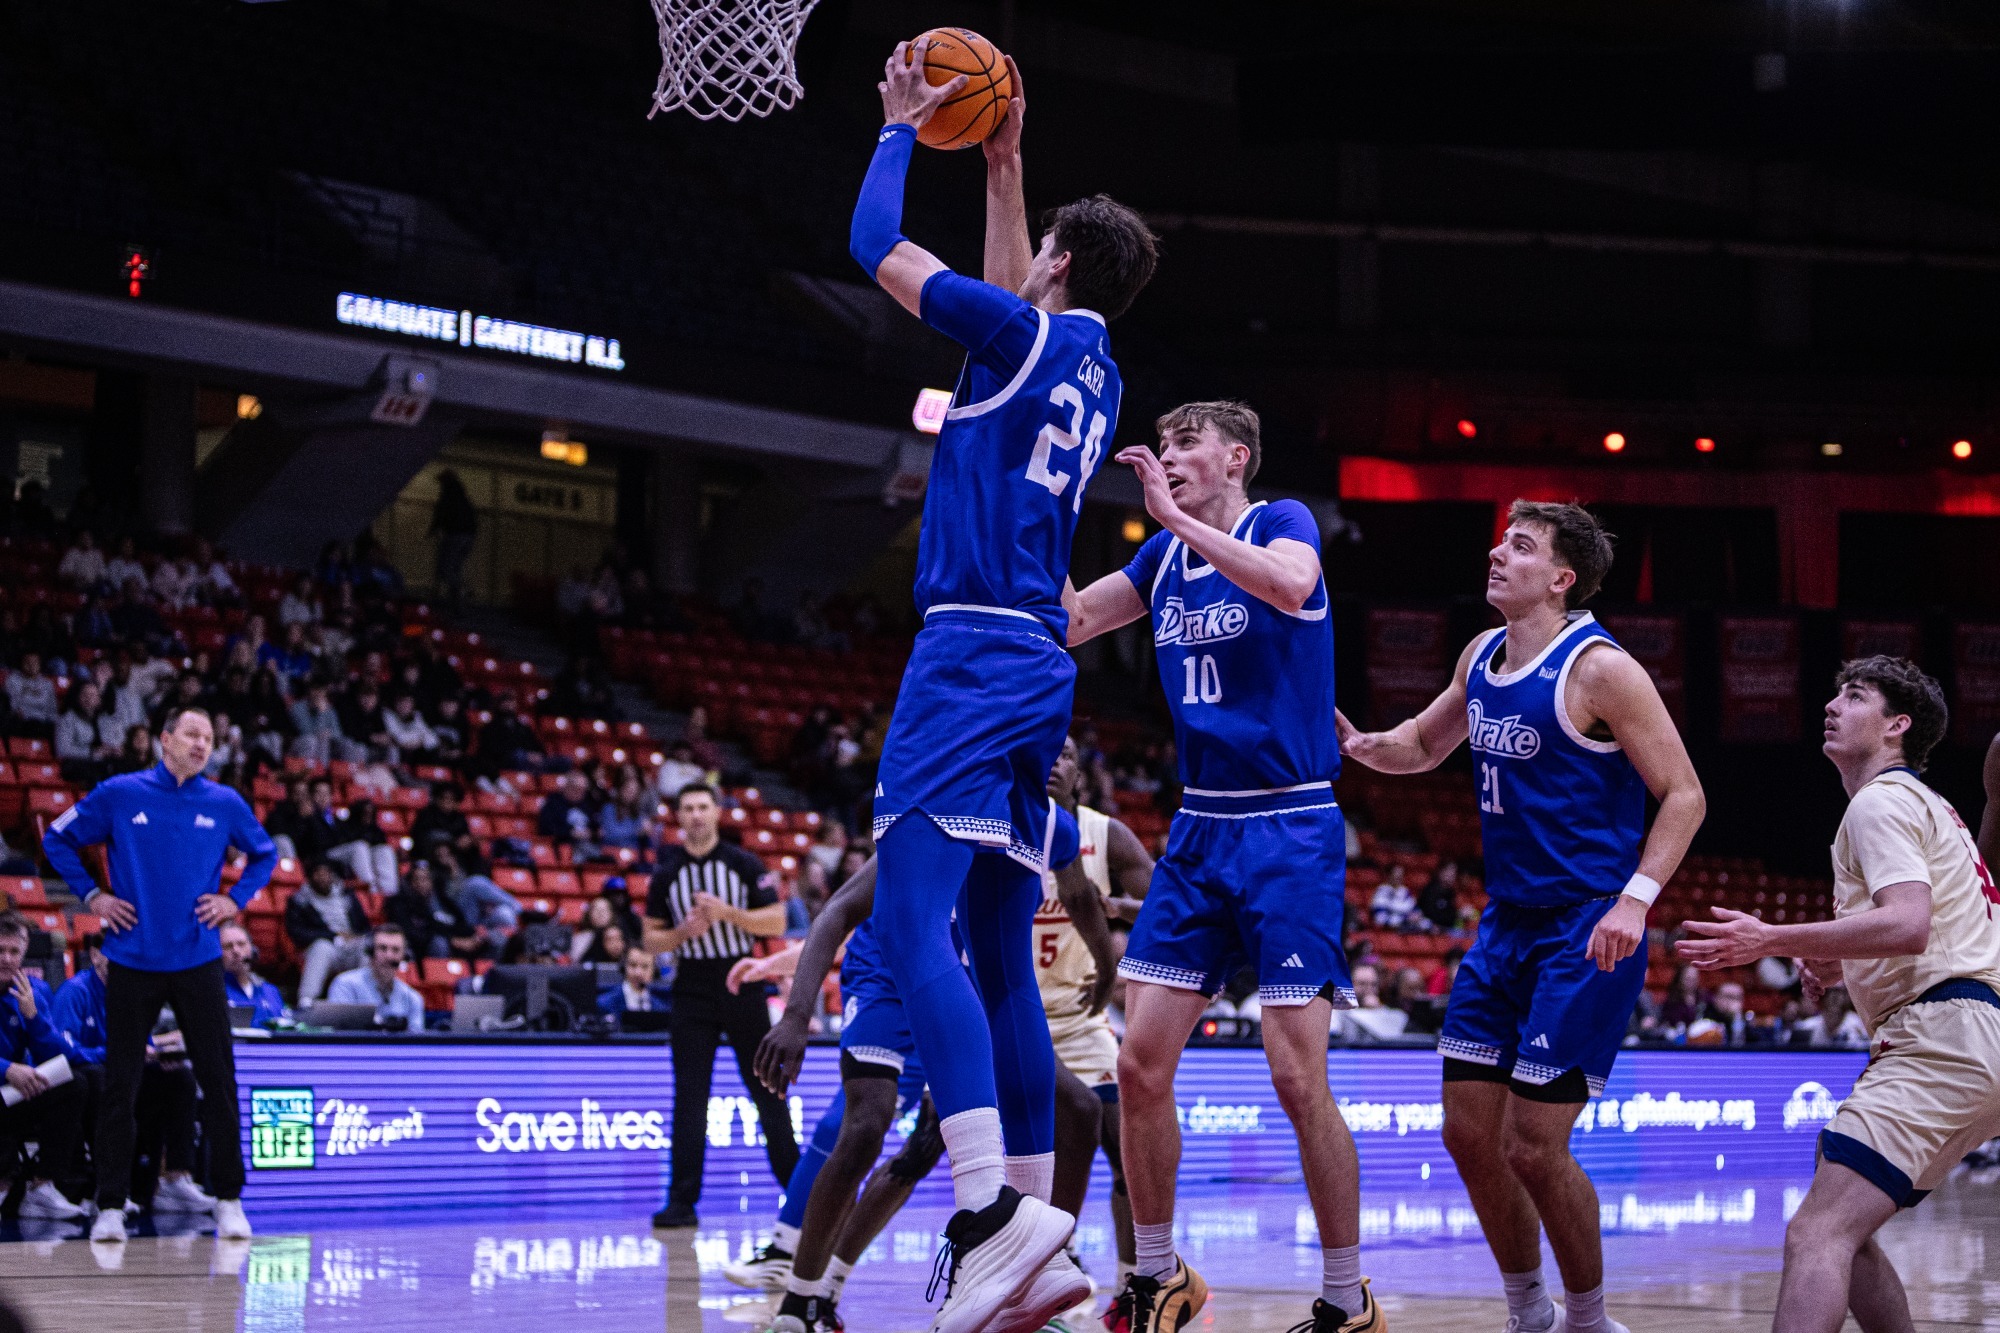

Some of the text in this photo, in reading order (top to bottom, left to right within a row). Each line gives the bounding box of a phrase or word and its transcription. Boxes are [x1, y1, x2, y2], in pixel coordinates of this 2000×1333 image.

[336, 291, 458, 341] GRADUATE
[1076, 353, 1106, 399] CARR
[1024, 381, 1107, 515] 24
[1155, 596, 1249, 647] Drake
[1182, 653, 1223, 705] 10
[1467, 698, 1541, 760] Drake
[1481, 761, 1505, 815] 21
[1039, 933, 1059, 968] 5
[253, 1127, 314, 1157] LIFE
[475, 1096, 577, 1152] Save
[580, 1096, 672, 1151] lives.
